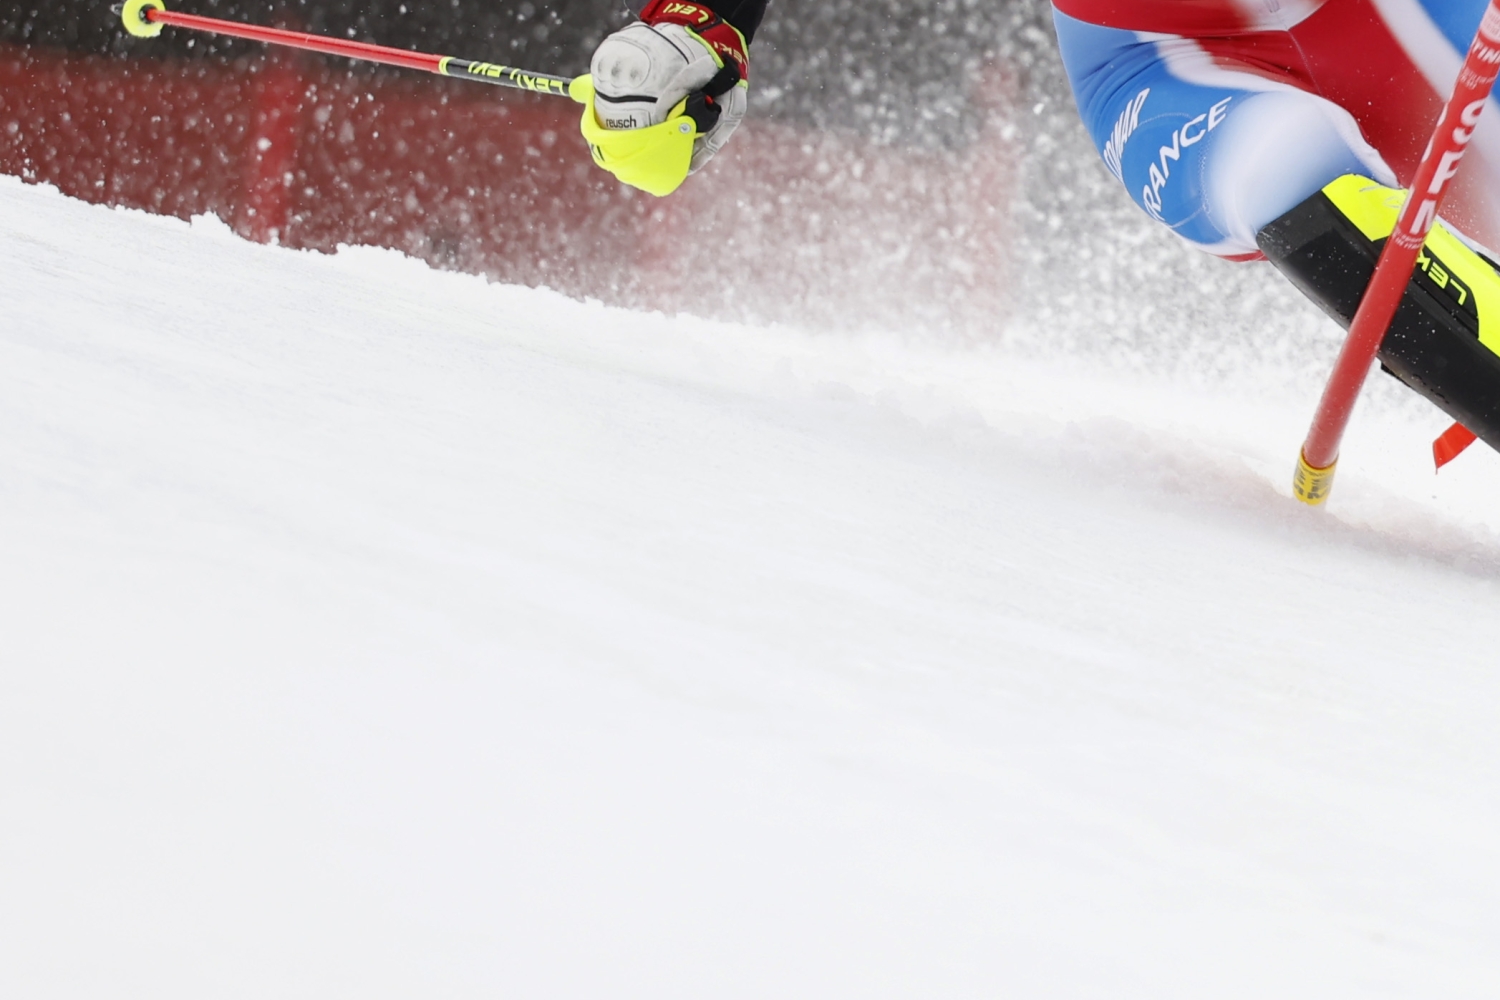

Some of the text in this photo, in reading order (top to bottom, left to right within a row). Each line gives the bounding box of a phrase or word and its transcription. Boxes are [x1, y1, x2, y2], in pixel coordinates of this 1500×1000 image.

[663, 2, 709, 24] LEKI
[605, 114, 637, 129] reusch
[1143, 96, 1232, 222] RANCE
[1416, 249, 1467, 306] LEK
